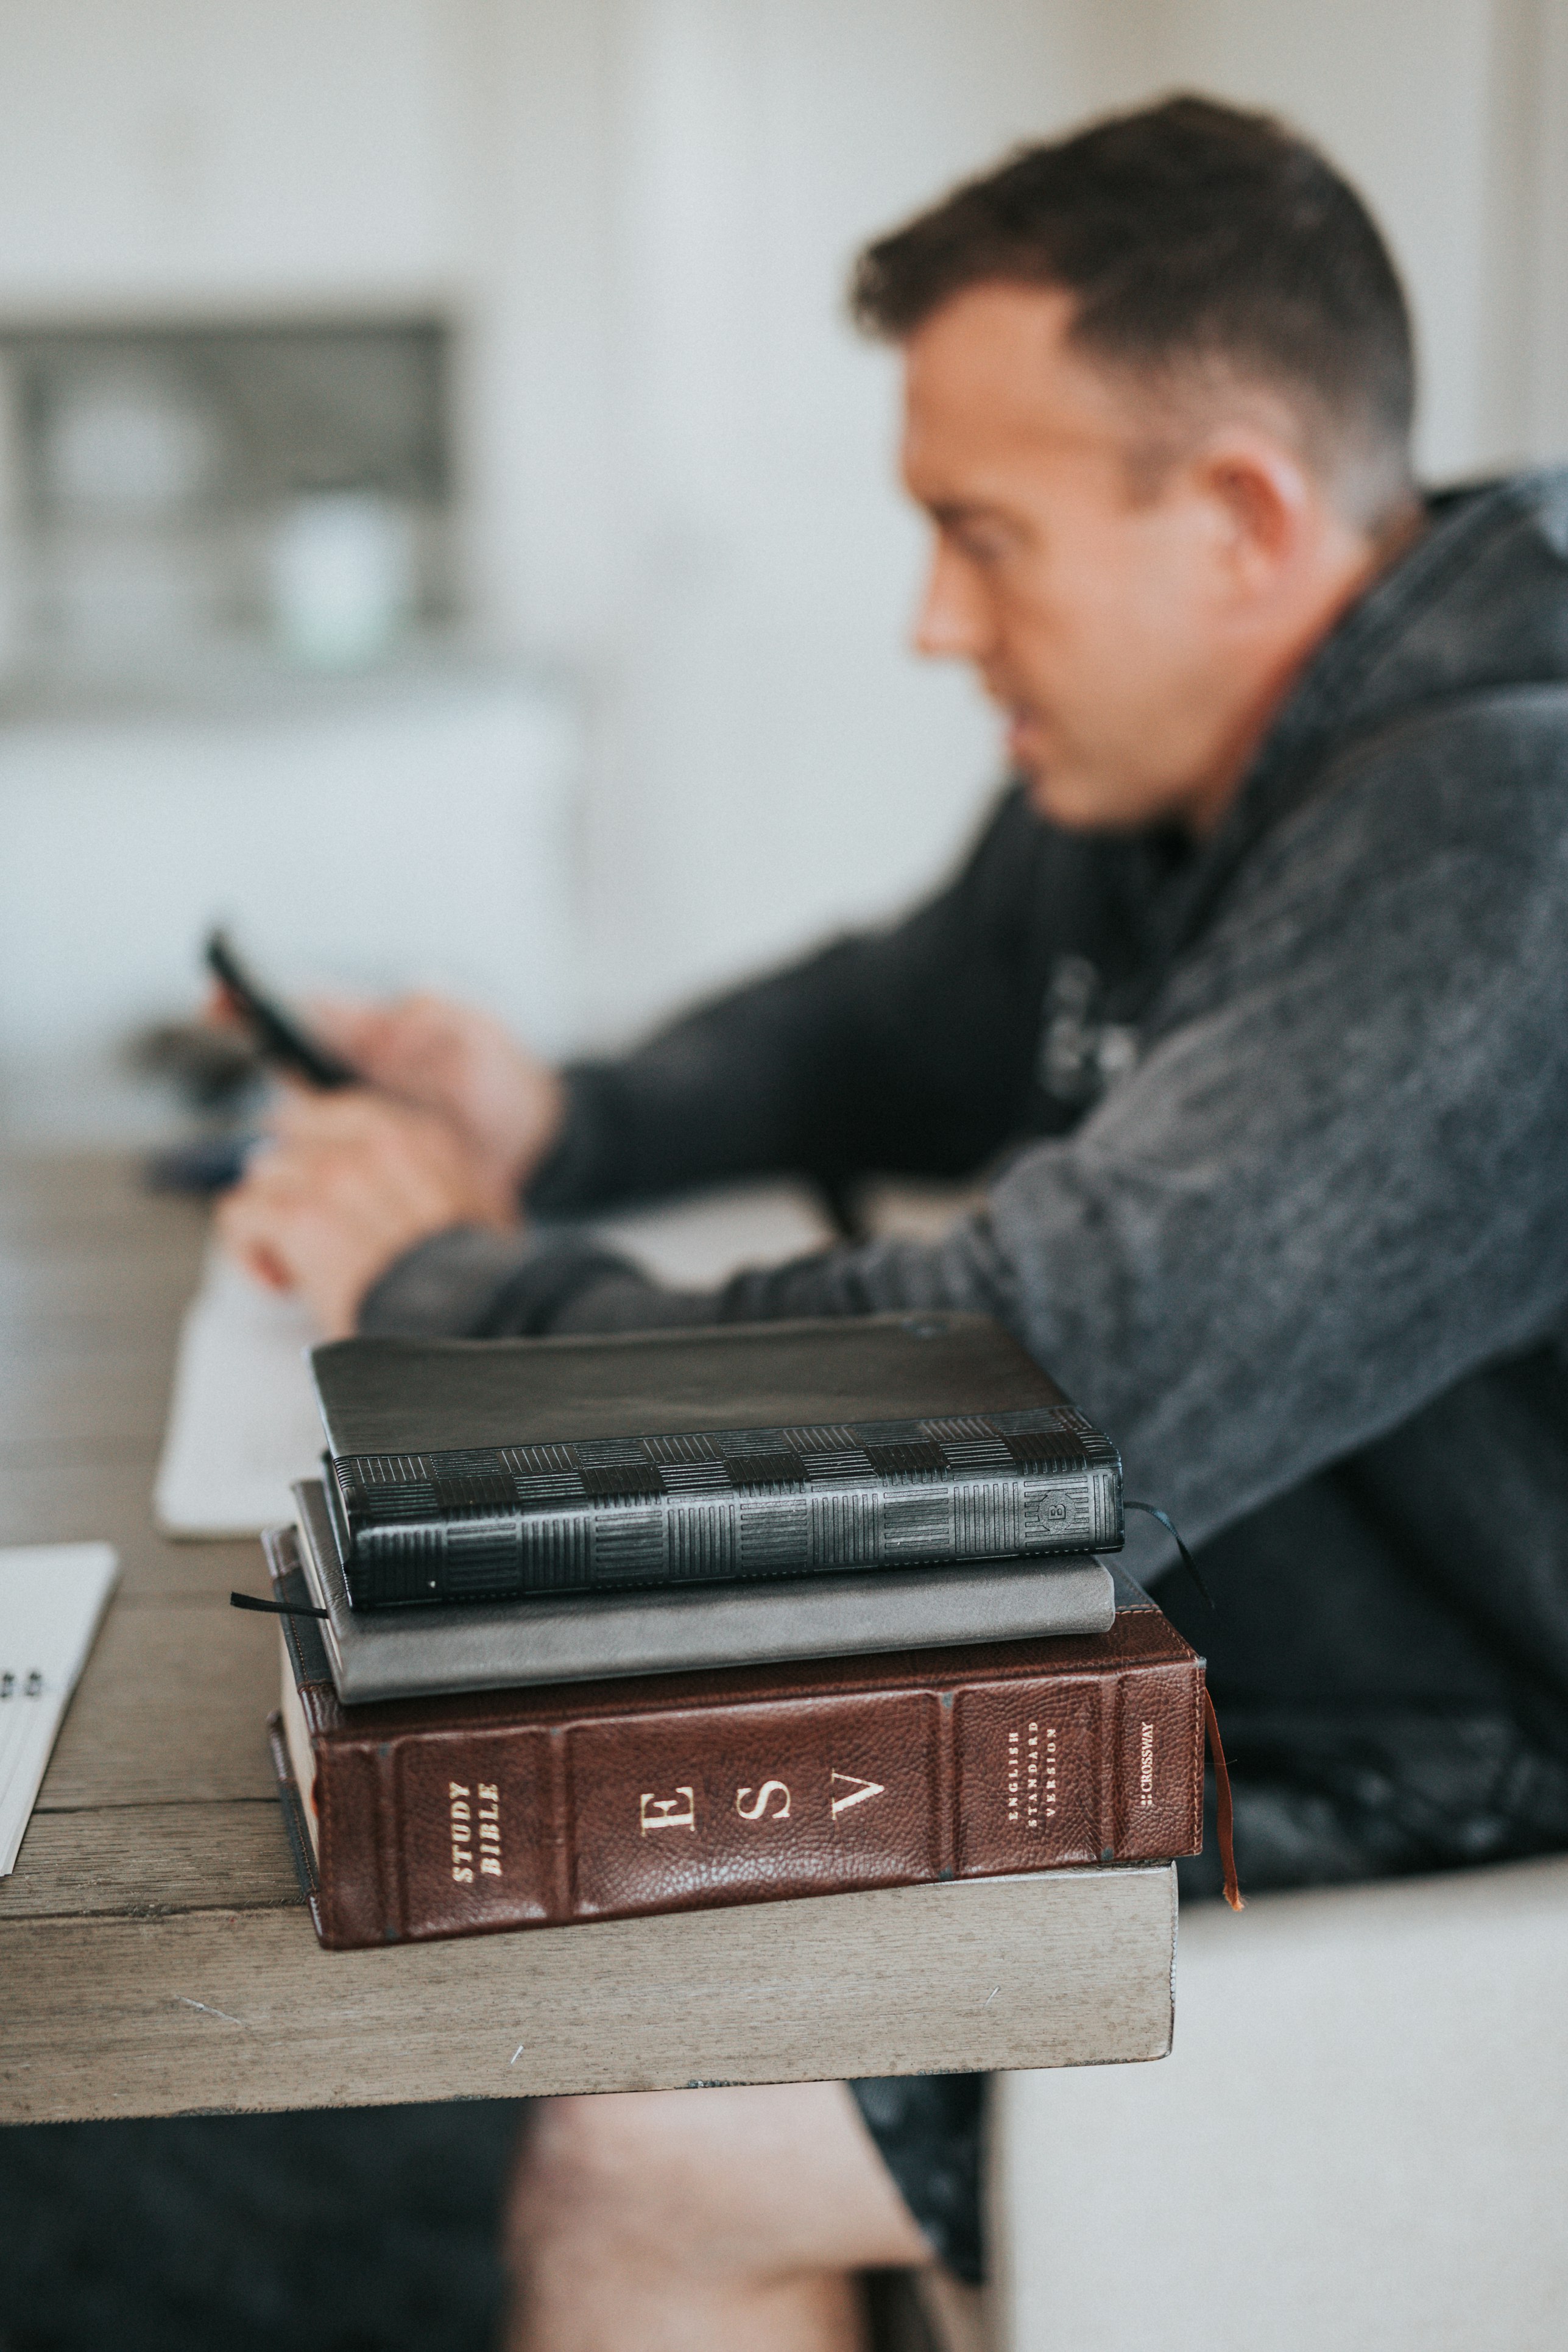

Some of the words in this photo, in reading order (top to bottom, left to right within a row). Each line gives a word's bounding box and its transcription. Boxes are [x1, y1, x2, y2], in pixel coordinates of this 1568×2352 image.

[1047, 1503, 1066, 1520] B
[1009, 1732, 1019, 1821] ENGLISH
[1028, 1722, 1039, 1827] STANDARD
[1047, 1729, 1057, 1817] VERSION
[1141, 1722, 1153, 1792] CROSSWAY
[449, 1782, 474, 1883] STUDY
[478, 1784, 502, 1877] BIBLE
